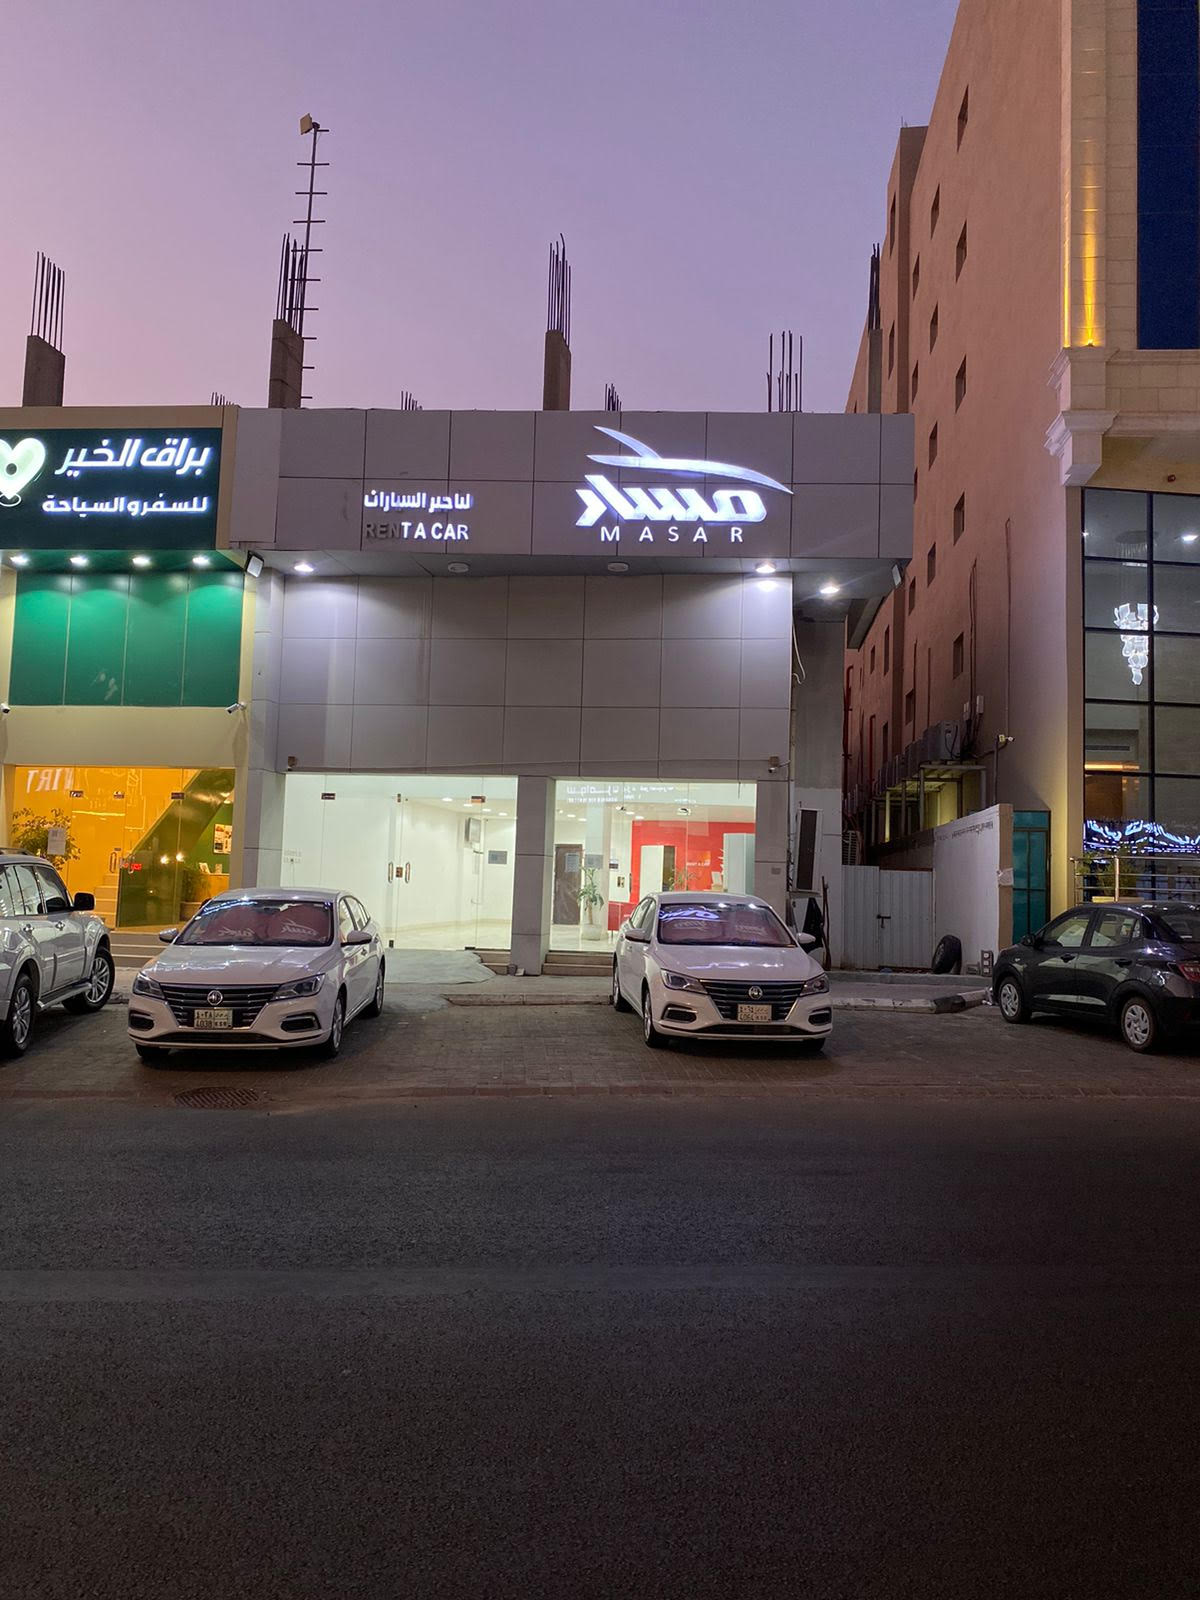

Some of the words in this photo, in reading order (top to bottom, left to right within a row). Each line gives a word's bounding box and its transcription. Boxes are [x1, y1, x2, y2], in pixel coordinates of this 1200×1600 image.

[54, 437, 143, 477] الخير
[141, 437, 212, 476] براق
[365, 521, 412, 539] RENT
[414, 522, 426, 540] A
[431, 522, 469, 540] CAR
